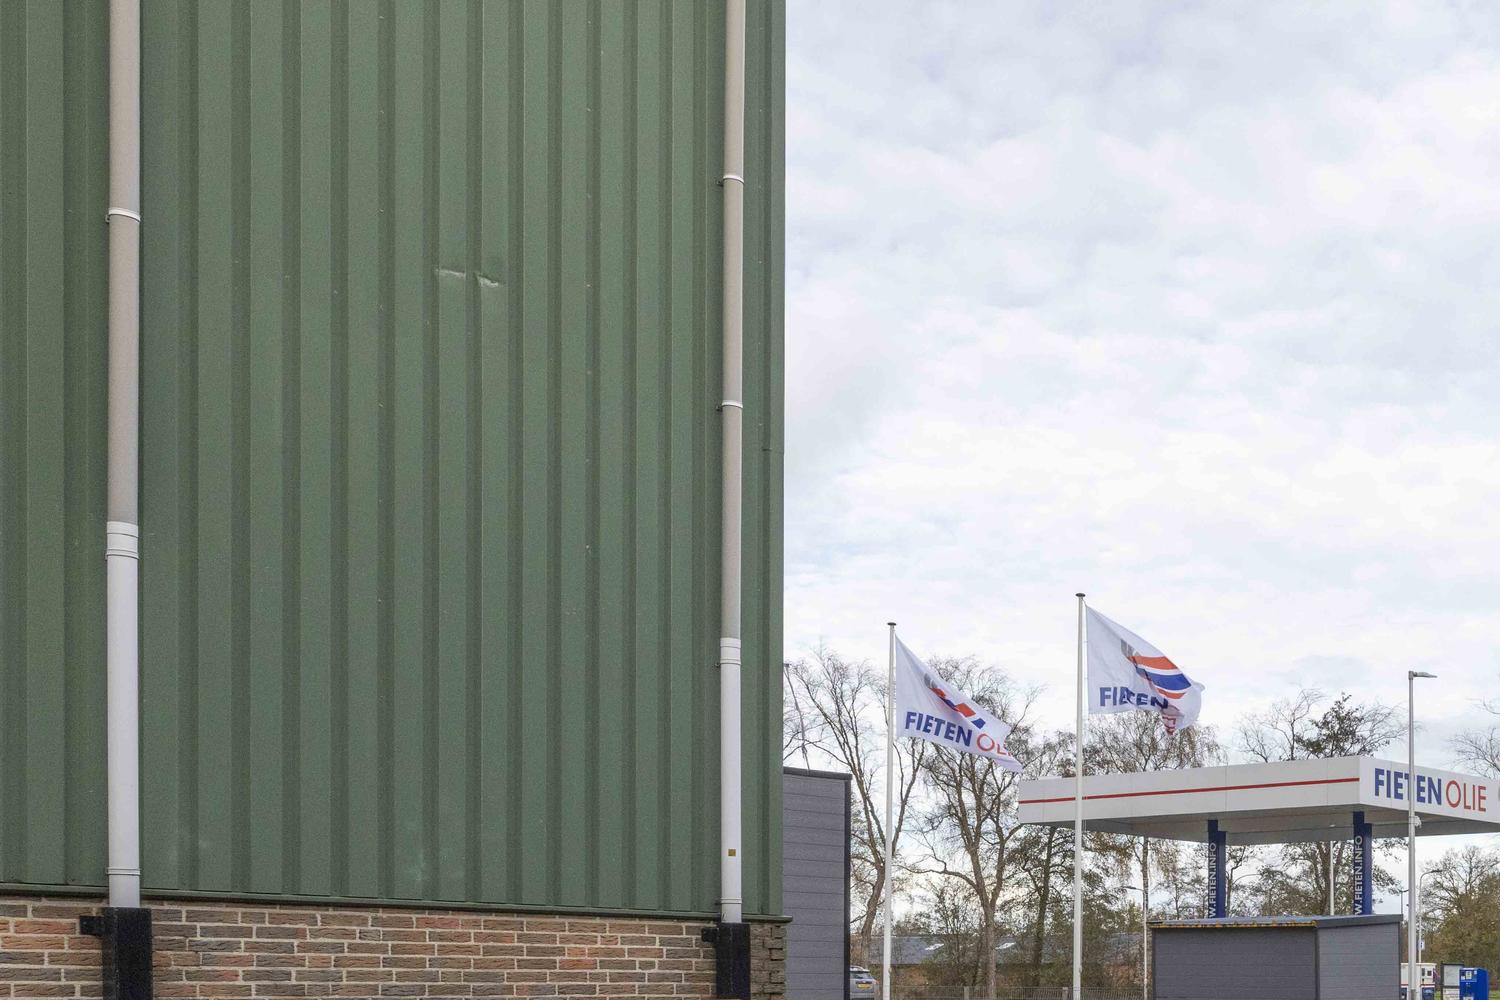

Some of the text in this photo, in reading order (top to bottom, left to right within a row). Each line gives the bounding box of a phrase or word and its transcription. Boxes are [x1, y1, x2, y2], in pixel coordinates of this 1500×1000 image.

[905, 711, 1013, 757] FIETEN OL
[1446, 780, 1487, 812] OLIE
